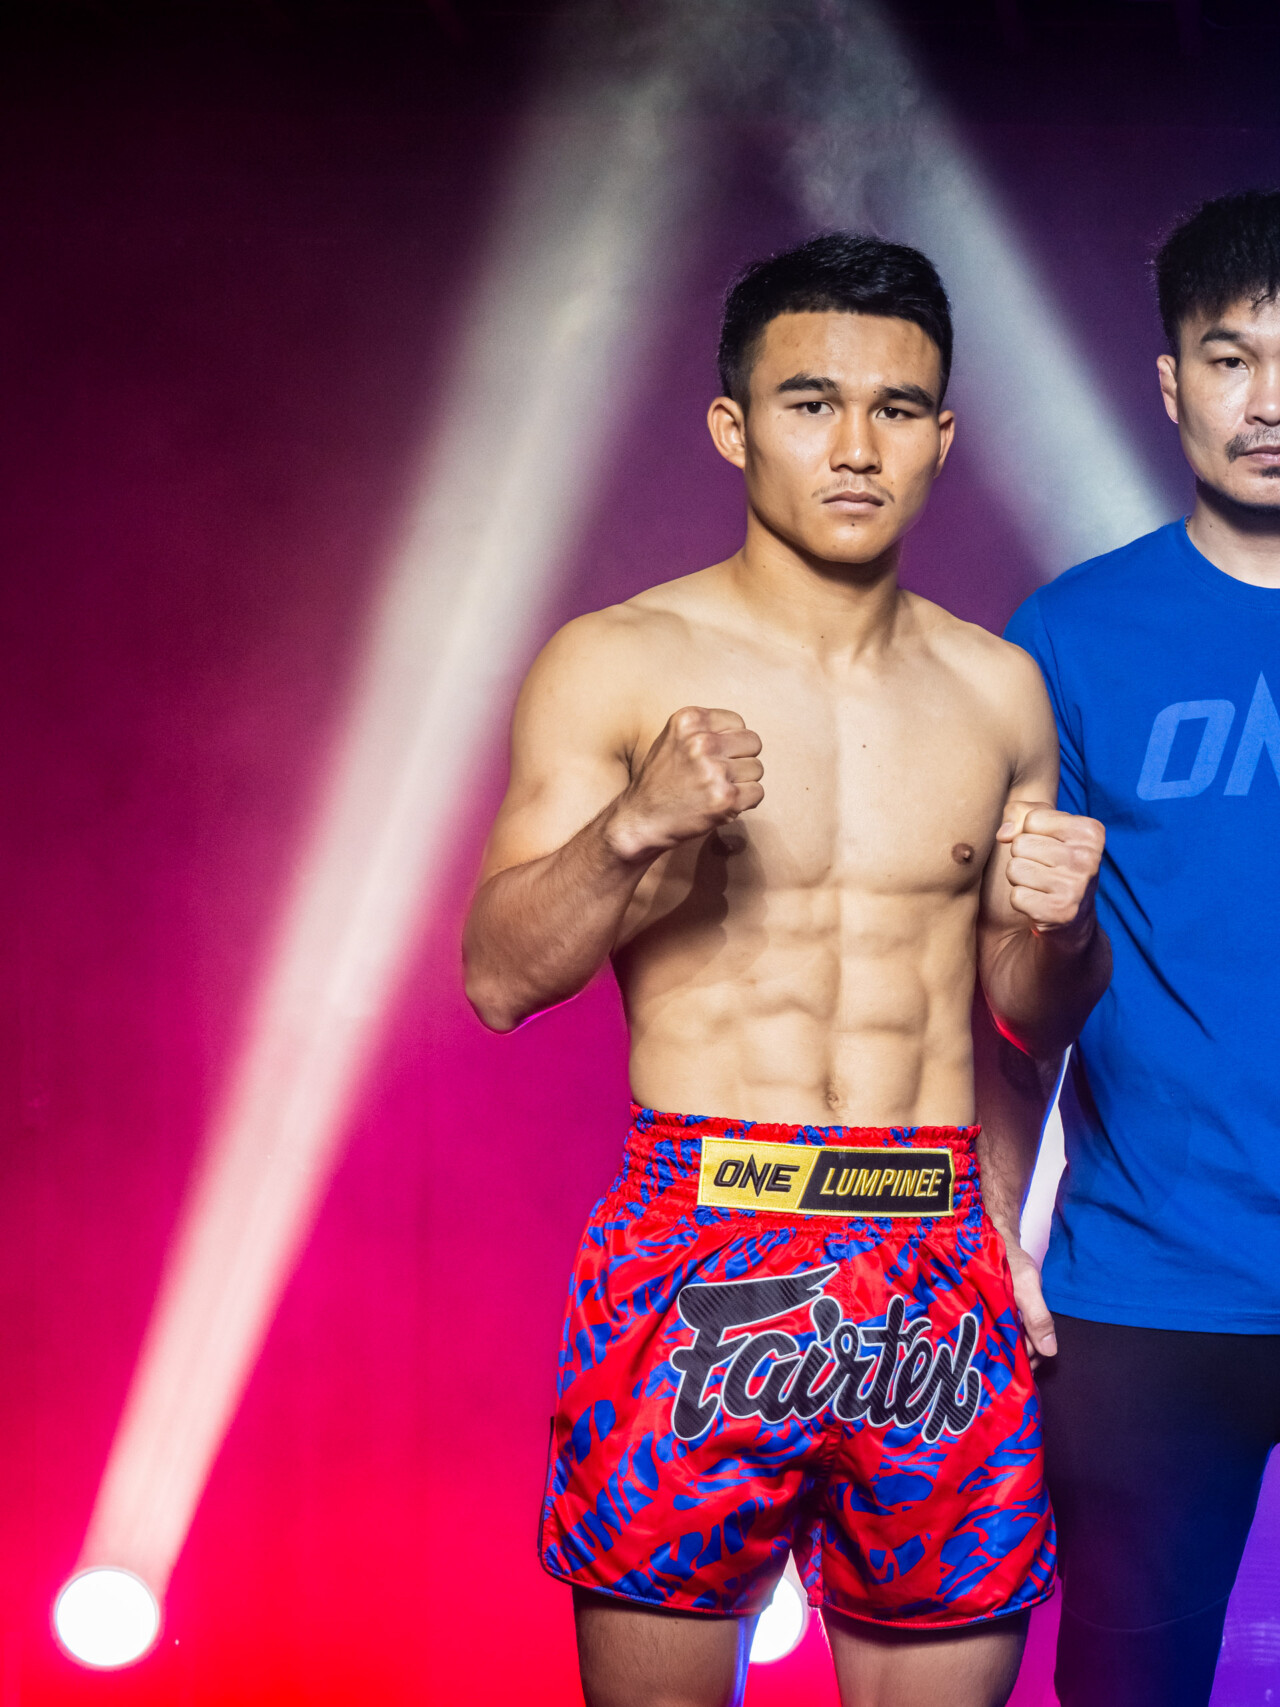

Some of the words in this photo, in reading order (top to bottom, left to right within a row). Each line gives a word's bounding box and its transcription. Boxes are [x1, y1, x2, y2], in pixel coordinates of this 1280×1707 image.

[713, 1154, 800, 1197] ONE
[819, 1168, 945, 1197] LUMPINEE
[669, 1263, 982, 1444] Fairtex
